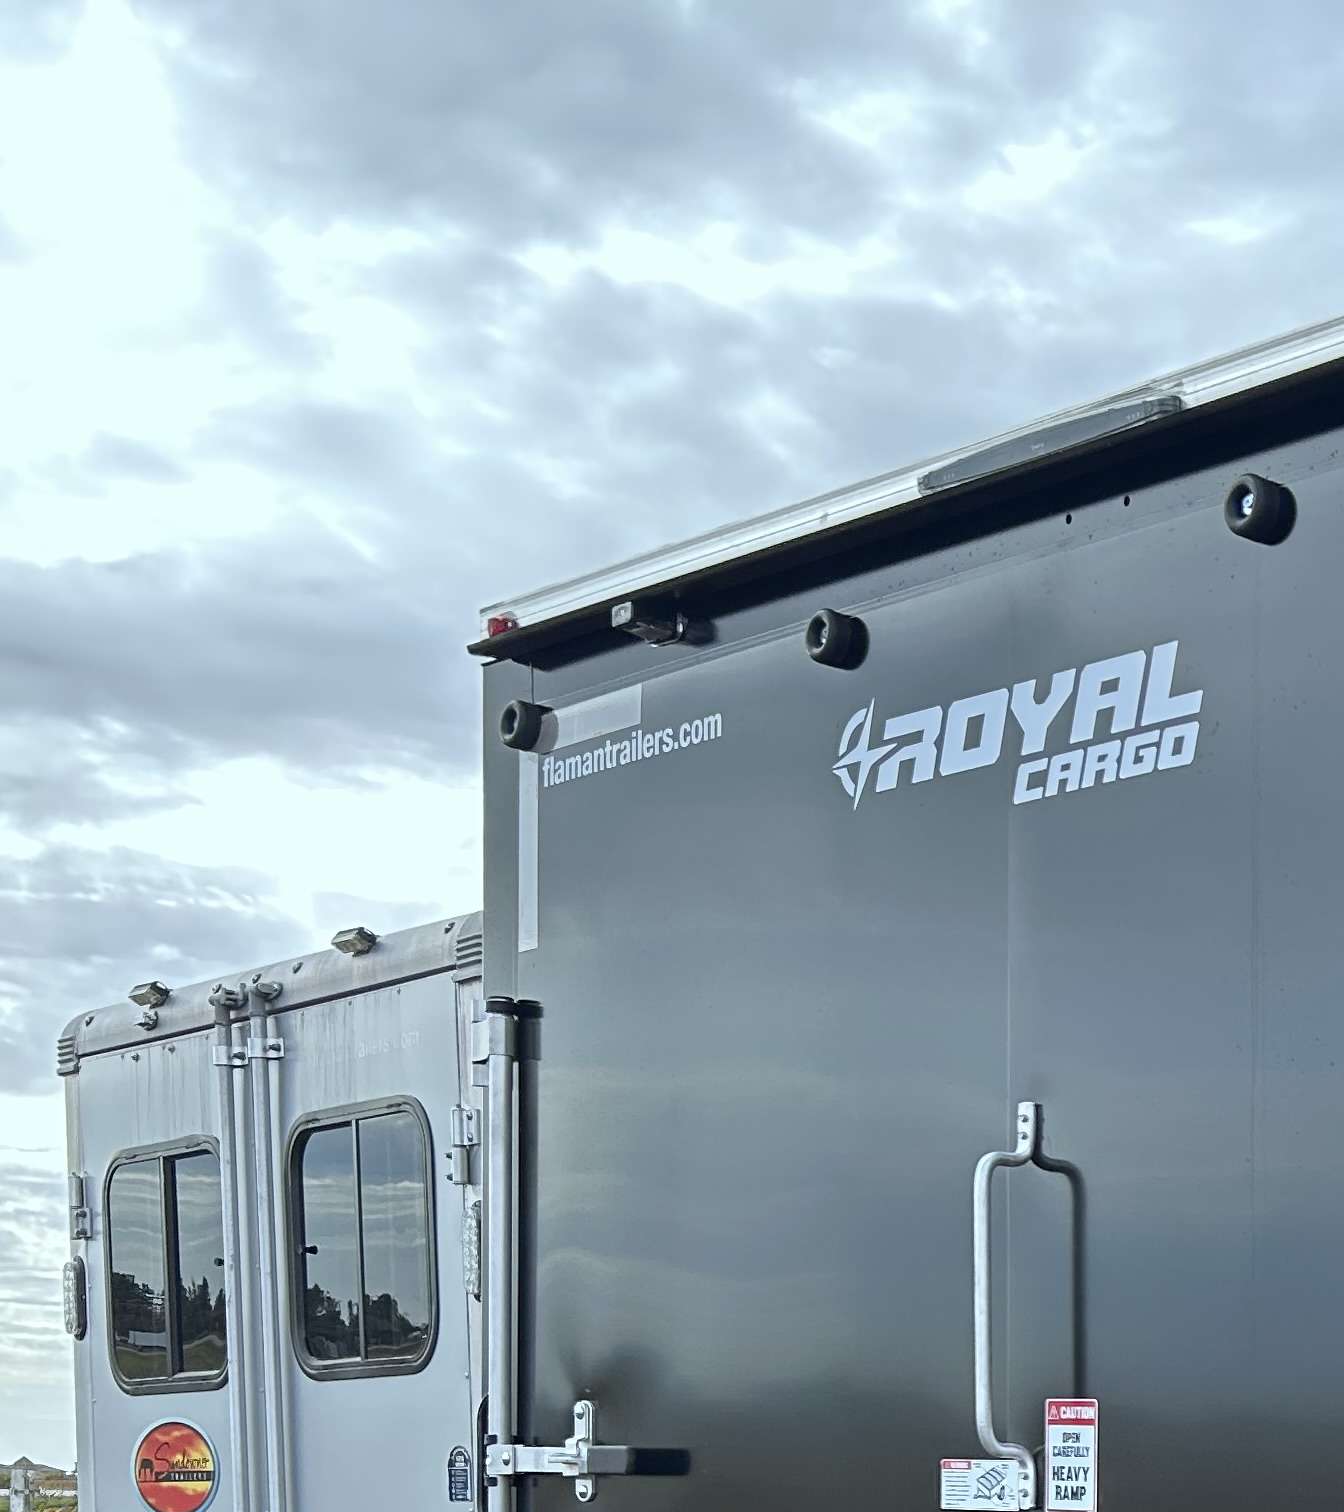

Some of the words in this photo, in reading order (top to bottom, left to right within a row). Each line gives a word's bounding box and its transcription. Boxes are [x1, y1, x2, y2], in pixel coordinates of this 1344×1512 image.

[875, 640, 1203, 793] ROYAL
[542, 713, 722, 787] flamantrailers.com
[1013, 721, 1200, 804] CARGO
[1059, 1405, 1096, 1420] CAUTION
[1062, 1432, 1081, 1444] OPEN
[1052, 1446, 1090, 1458] CAREFULLY
[1052, 1465, 1090, 1482] HEAVY
[1055, 1485, 1087, 1501] RAMP
